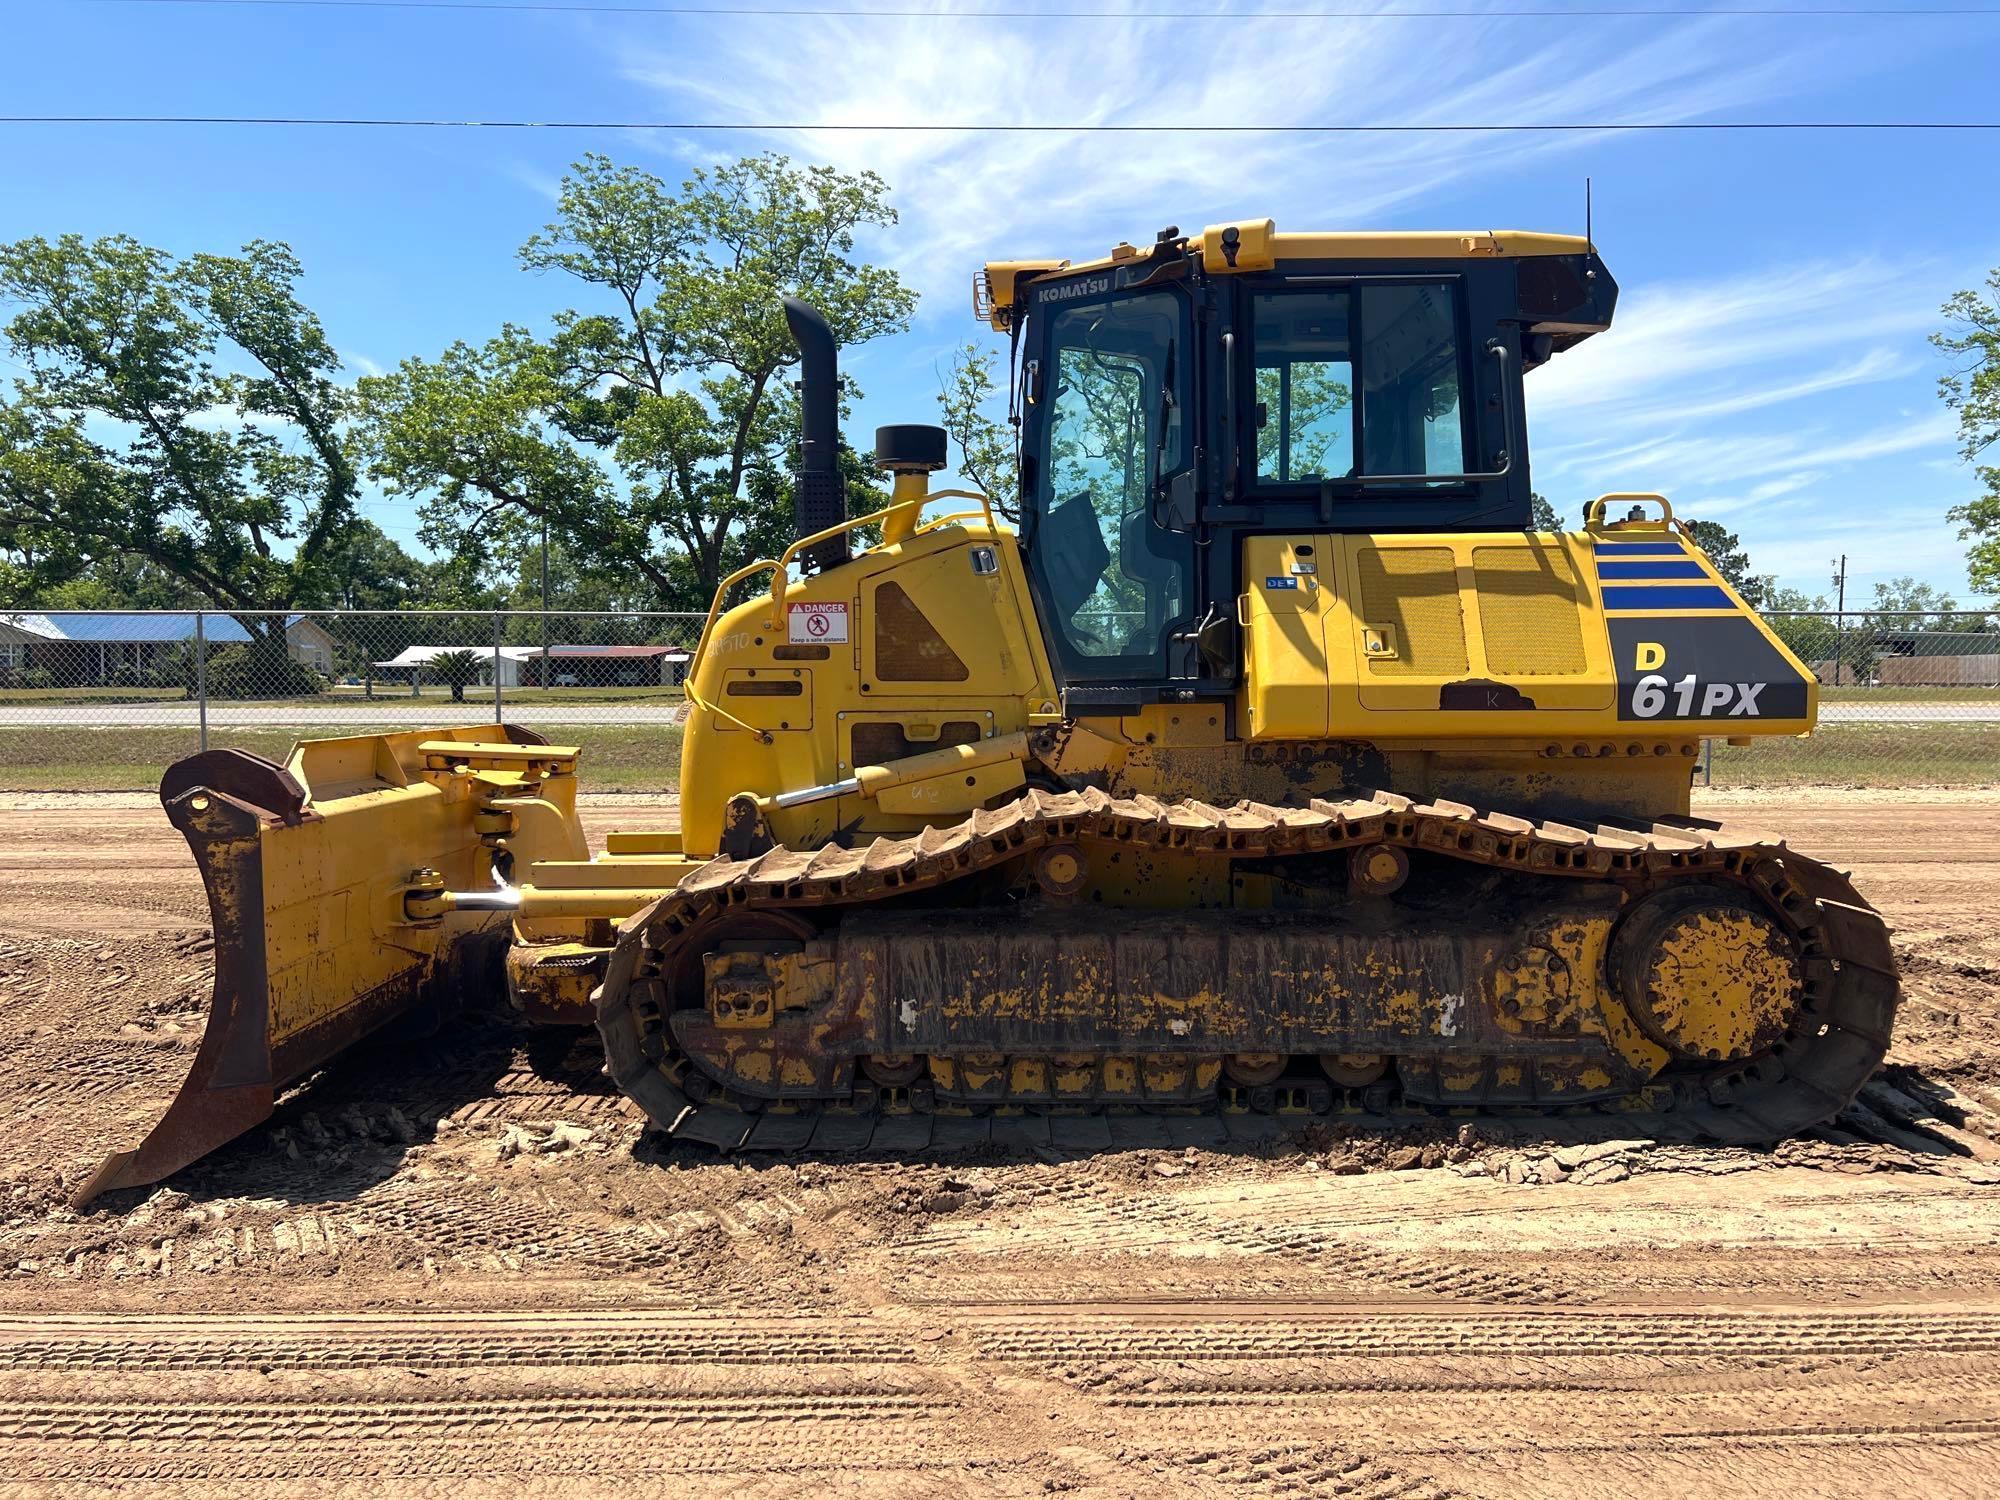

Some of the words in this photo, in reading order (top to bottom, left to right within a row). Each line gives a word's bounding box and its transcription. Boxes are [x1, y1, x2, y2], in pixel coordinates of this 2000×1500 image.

[1039, 279, 1108, 303] KOMATSU
[1267, 579, 1295, 588] DEF
[804, 604, 845, 613] DANGER
[1635, 642, 1666, 671] D
[1487, 690, 1499, 707] K
